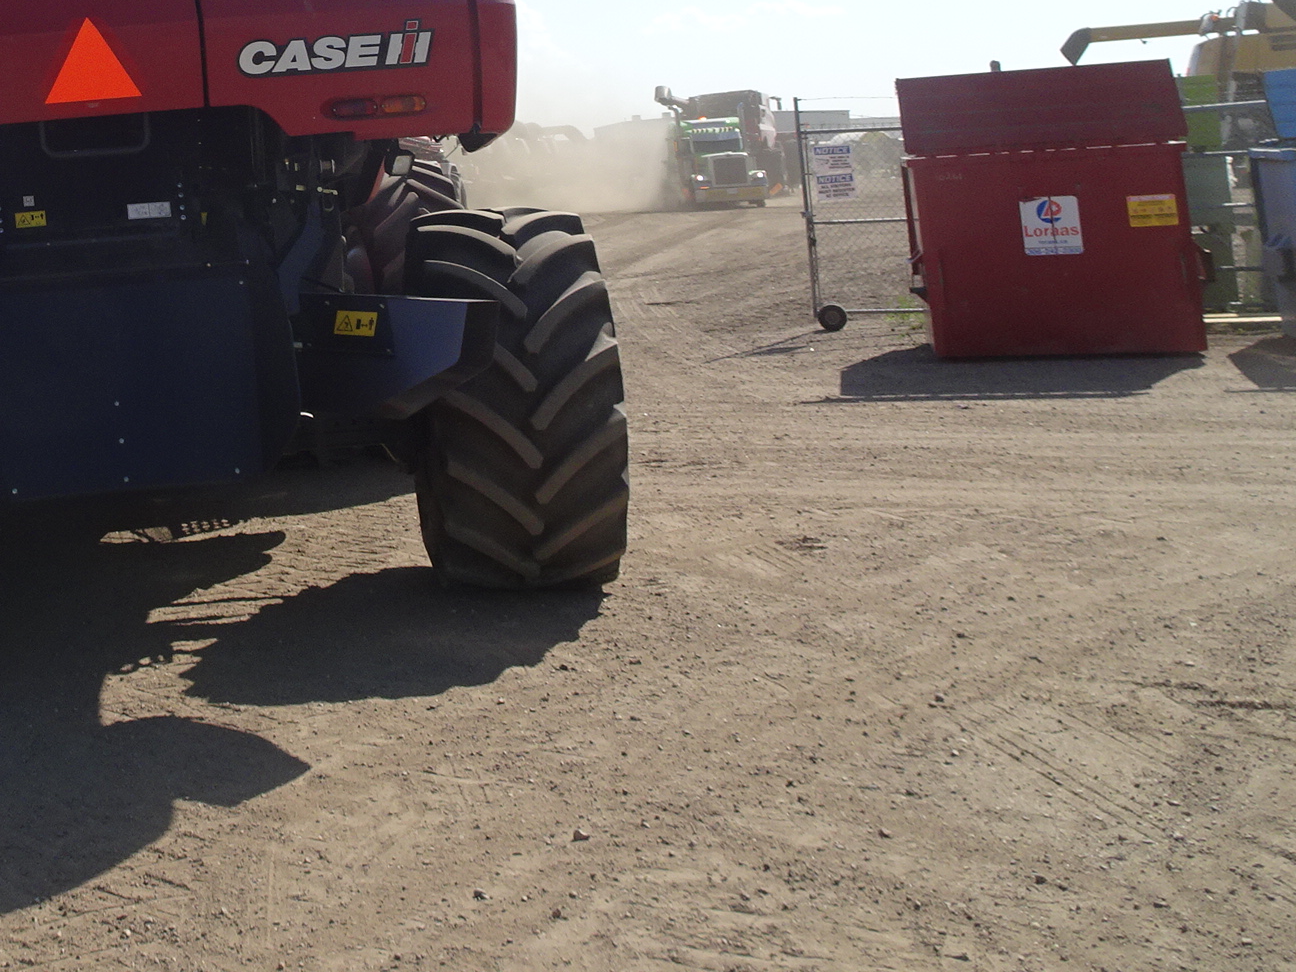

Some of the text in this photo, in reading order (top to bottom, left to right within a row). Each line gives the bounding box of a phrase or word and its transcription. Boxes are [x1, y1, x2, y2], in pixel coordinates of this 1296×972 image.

[239, 35, 381, 75] CASE
[815, 146, 849, 155] NOTICE
[817, 174, 852, 184] NOTICE
[1023, 225, 1080, 238] Loraas
